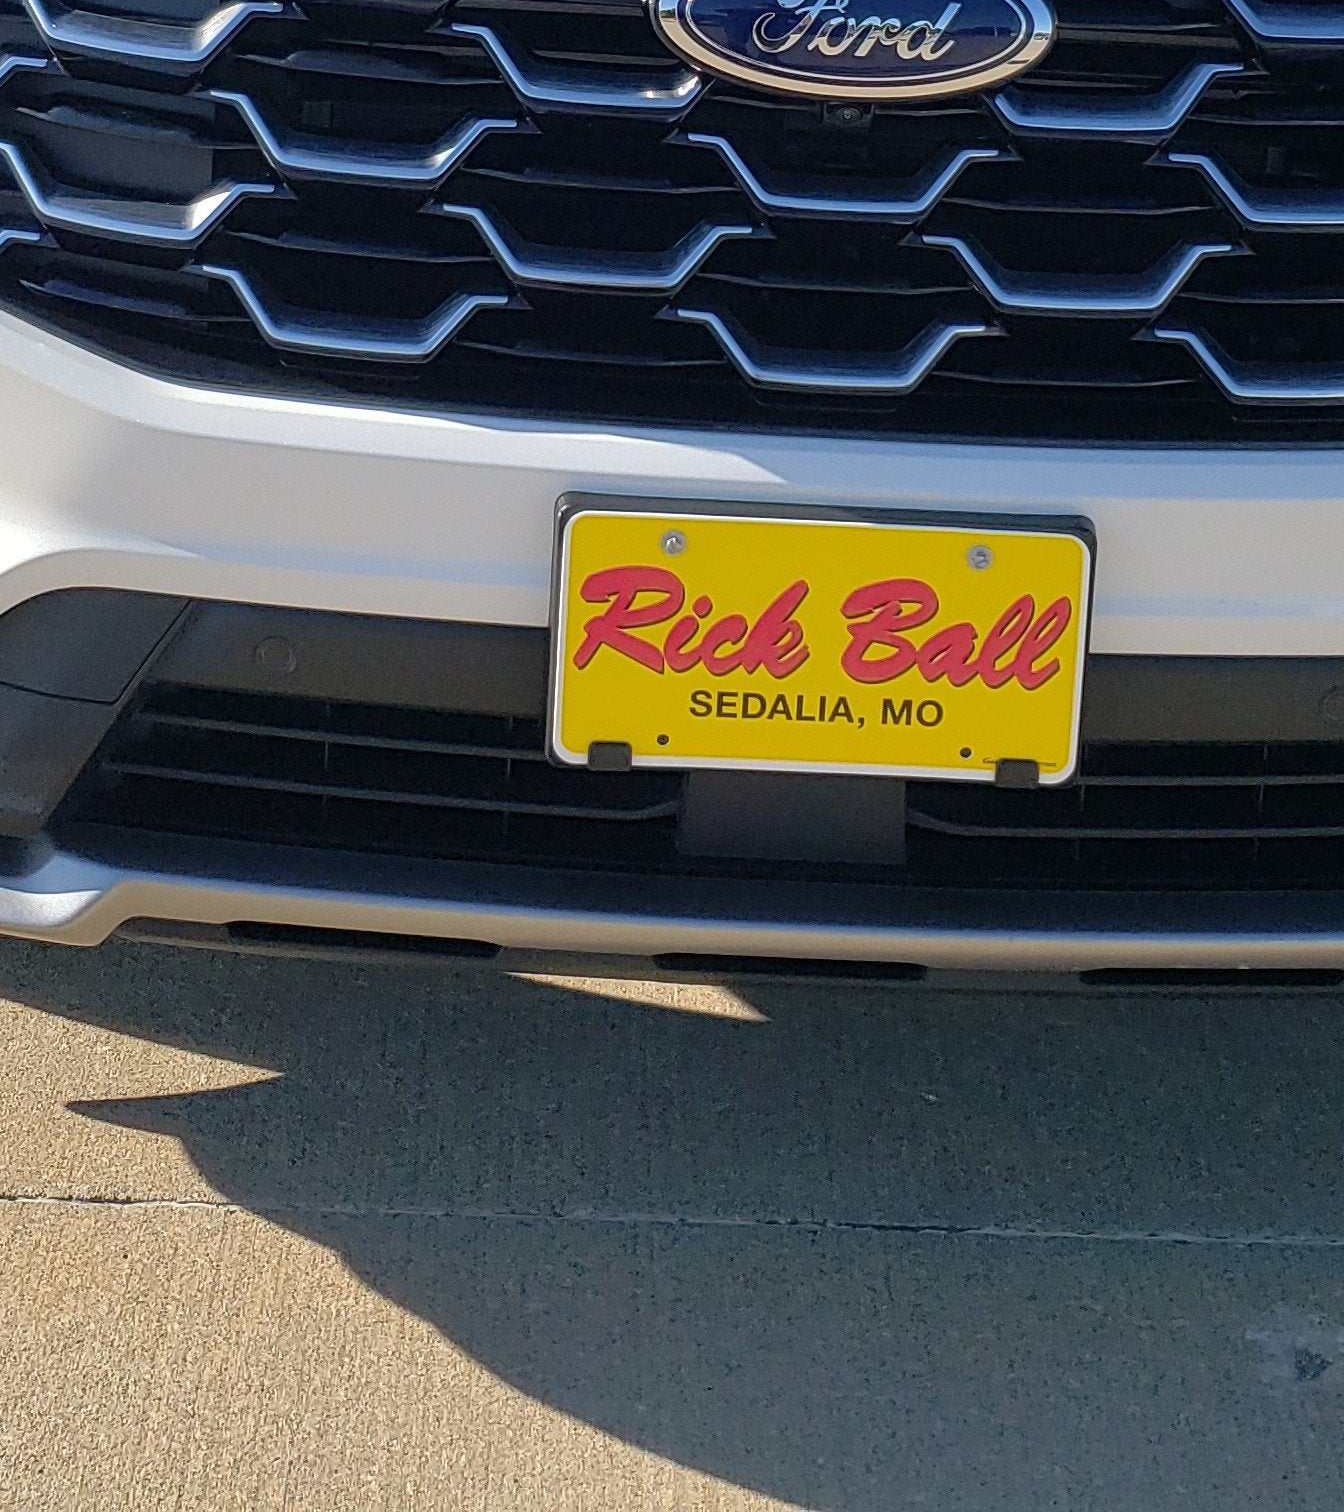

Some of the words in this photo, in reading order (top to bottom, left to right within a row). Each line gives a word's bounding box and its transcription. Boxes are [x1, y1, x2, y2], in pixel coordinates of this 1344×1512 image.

[573, 565, 810, 679] Rick
[839, 578, 1071, 691] Ball
[688, 689, 867, 730] SEDALIA,
[881, 698, 945, 728] MO
